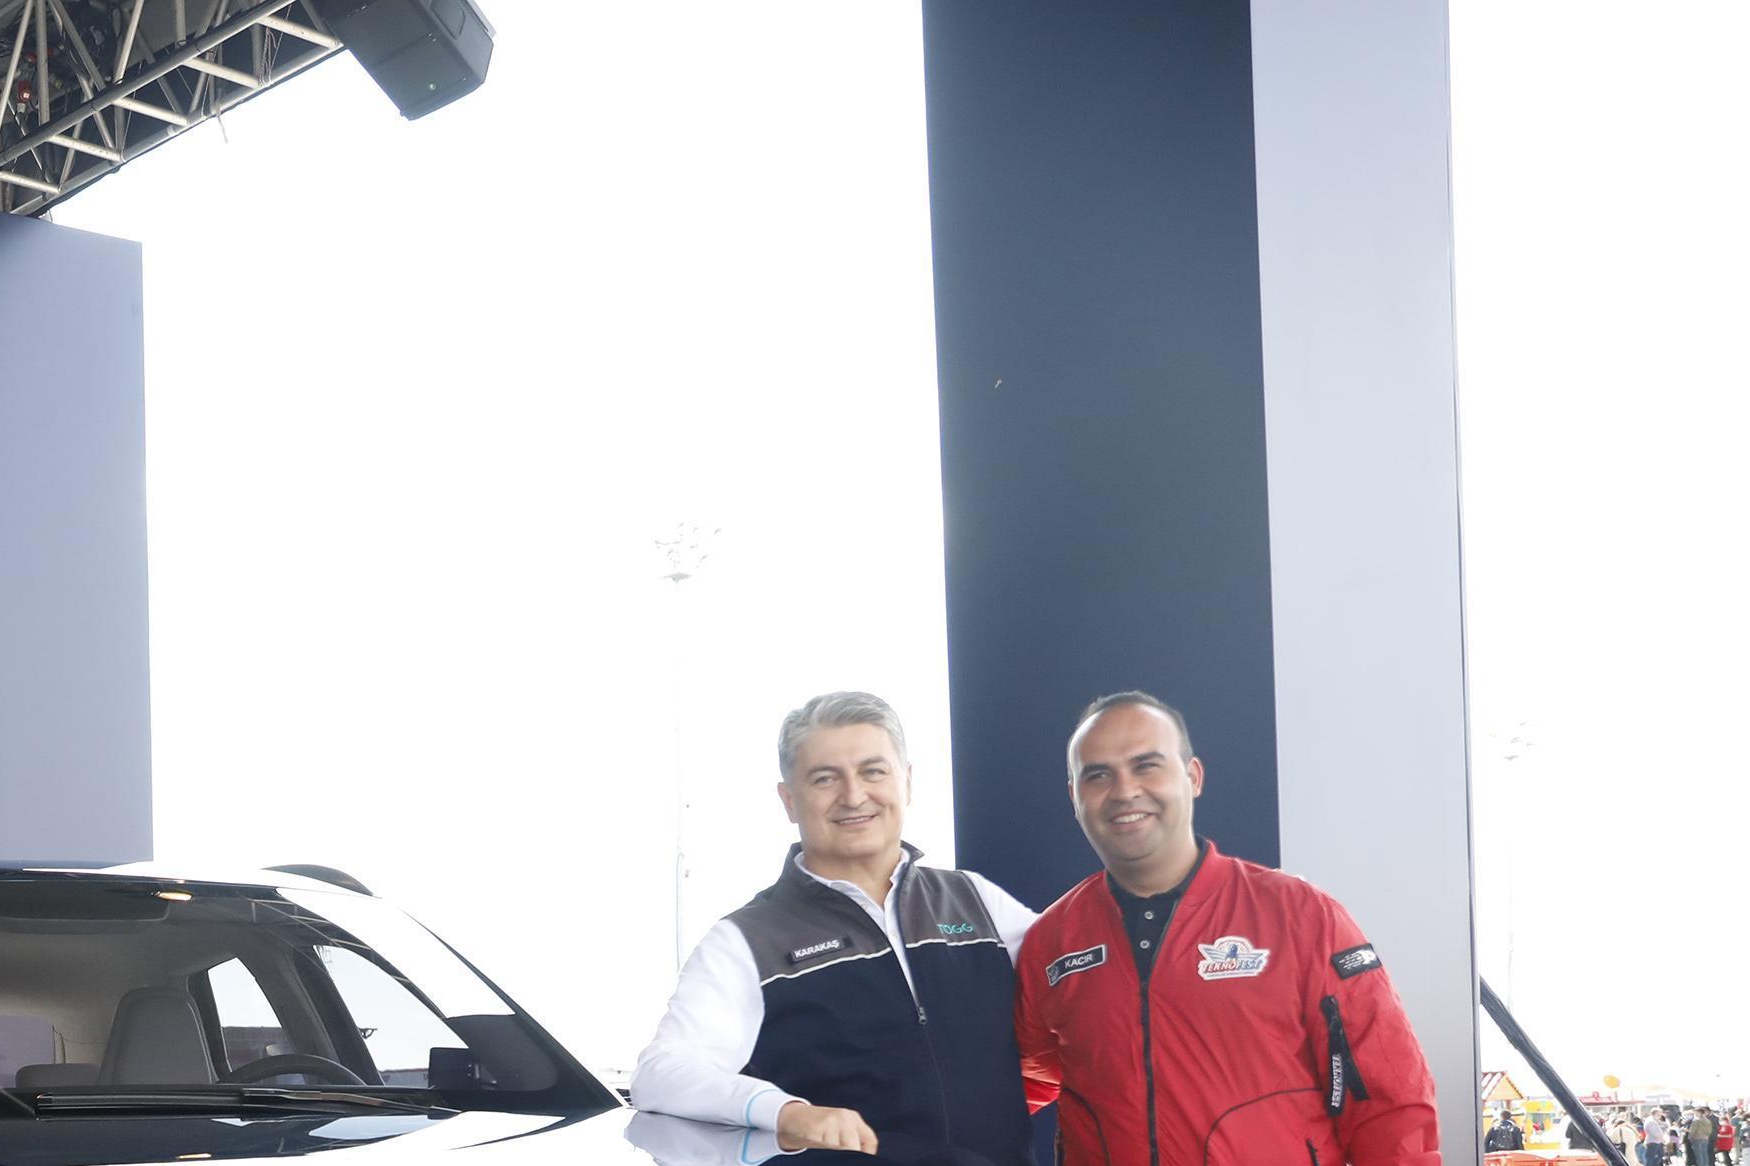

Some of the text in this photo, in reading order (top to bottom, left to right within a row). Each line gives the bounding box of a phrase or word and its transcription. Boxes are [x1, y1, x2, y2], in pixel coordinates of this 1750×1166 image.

[937, 923, 973, 935] TOGG
[793, 939, 840, 958] KARAKAŞ
[1064, 953, 1094, 969] KACIR
[1200, 958, 1264, 974] TEKNOFEST
